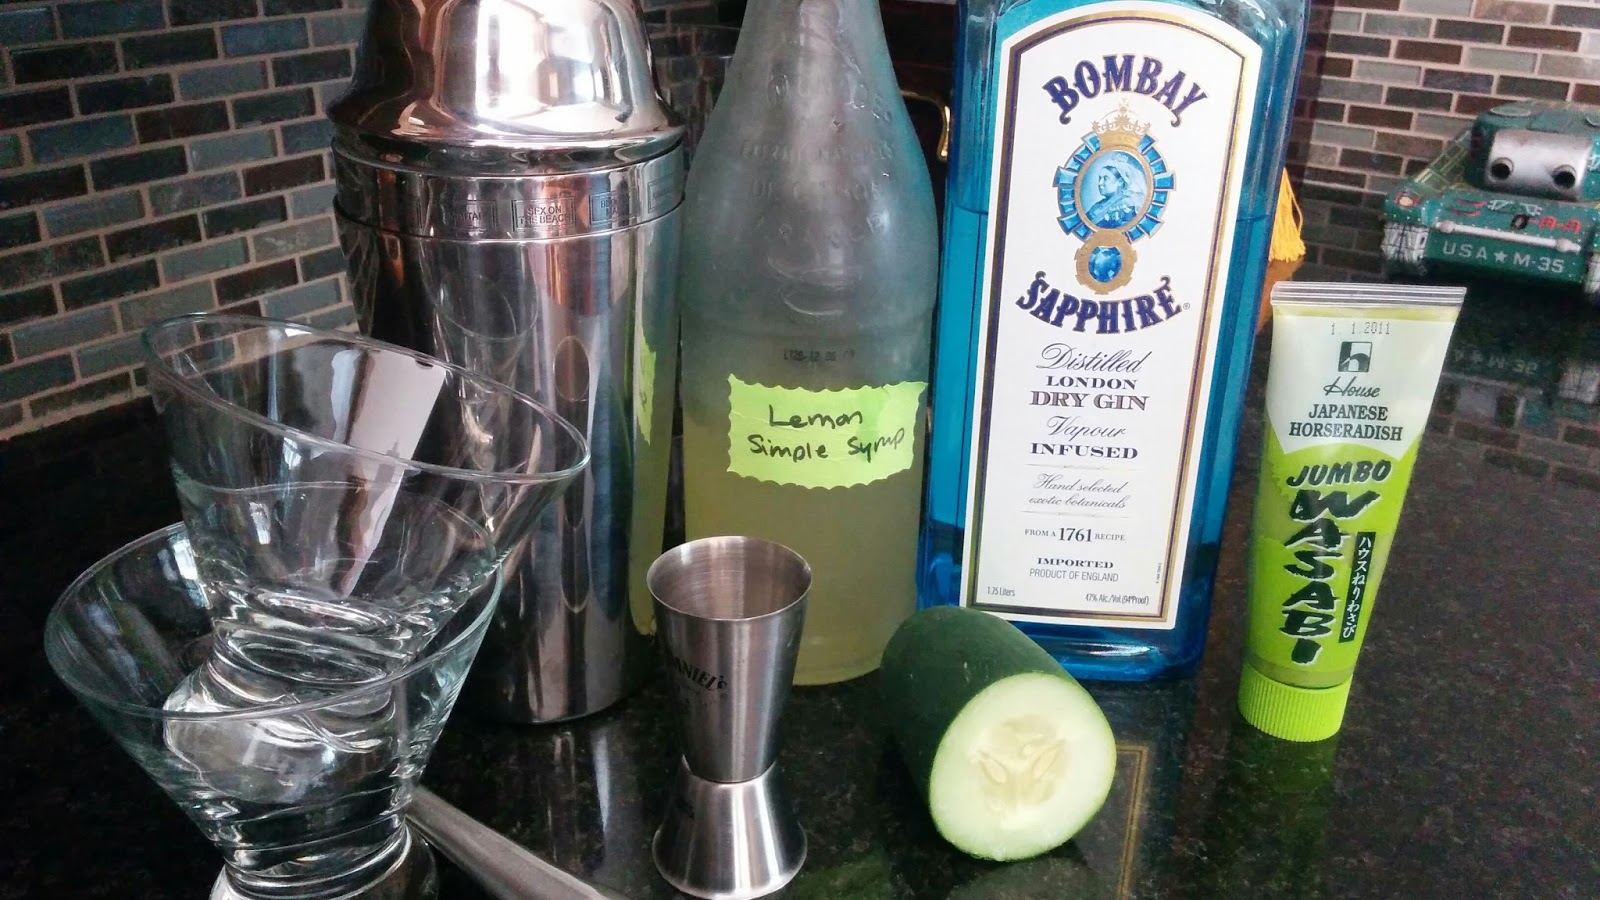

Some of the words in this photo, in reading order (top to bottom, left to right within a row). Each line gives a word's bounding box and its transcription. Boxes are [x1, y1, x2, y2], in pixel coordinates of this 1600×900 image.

[1041, 54, 1208, 128] BOMBAY
[519, 216, 538, 226] THE
[527, 207, 547, 216] SEX
[548, 205, 562, 215] ON
[1443, 241, 1487, 260] USA
[1513, 252, 1566, 273] M-35
[1015, 270, 1182, 334] SAPPHIRE
[1036, 343, 1152, 373] Distilled
[1046, 375, 1138, 390] LONDON
[1323, 376, 1381, 398] House
[1029, 390, 1090, 408] DRY
[1093, 393, 1150, 411] GIN
[769, 404, 863, 429] Lemon
[1308, 403, 1388, 421] JAPANESE
[1047, 415, 1126, 441] Vapour
[1289, 422, 1403, 441] HORSERADISH
[747, 434, 829, 463] Simple
[847, 427, 905, 463] Syrup
[1030, 442, 1138, 460] INFUSED
[1033, 473, 1076, 491] Hand
[1077, 481, 1129, 494] selected
[1286, 460, 1392, 486] JUMBO
[1028, 495, 1062, 506] exotic
[1063, 495, 1128, 509] botanicals
[1024, 528, 1050, 537] FROM
[1050, 530, 1057, 538] A
[1058, 527, 1093, 543] 1761
[1094, 533, 1126, 541] RECIPE
[1037, 557, 1114, 569] IMPORTED
[1029, 568, 1067, 580] PRODUCT
[1069, 571, 1080, 581] OF
[1081, 571, 1119, 583] ENGLAND
[1279, 489, 1381, 666] WASABI
[999, 588, 1016, 597] Liters
[1342, 536, 1372, 639] ハウスねりわさび
